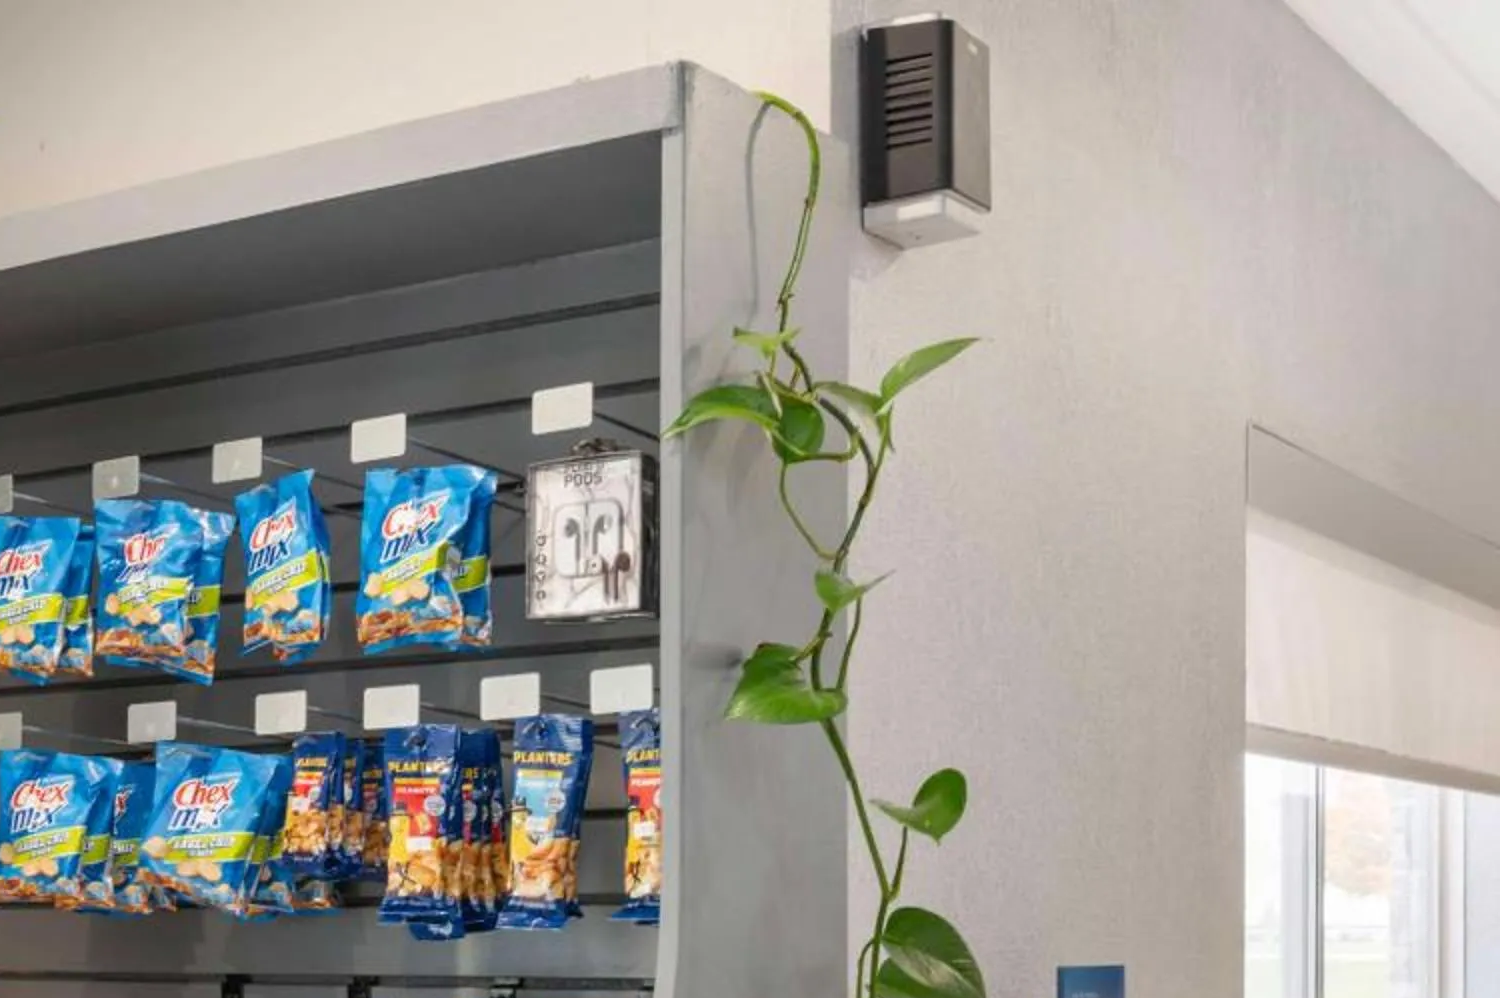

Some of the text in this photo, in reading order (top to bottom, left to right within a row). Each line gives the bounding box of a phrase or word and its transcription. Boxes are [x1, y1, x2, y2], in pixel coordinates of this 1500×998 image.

[513, 751, 574, 766] PLANTERS
[626, 749, 660, 763] PLANT
[173, 779, 234, 809] Chex
